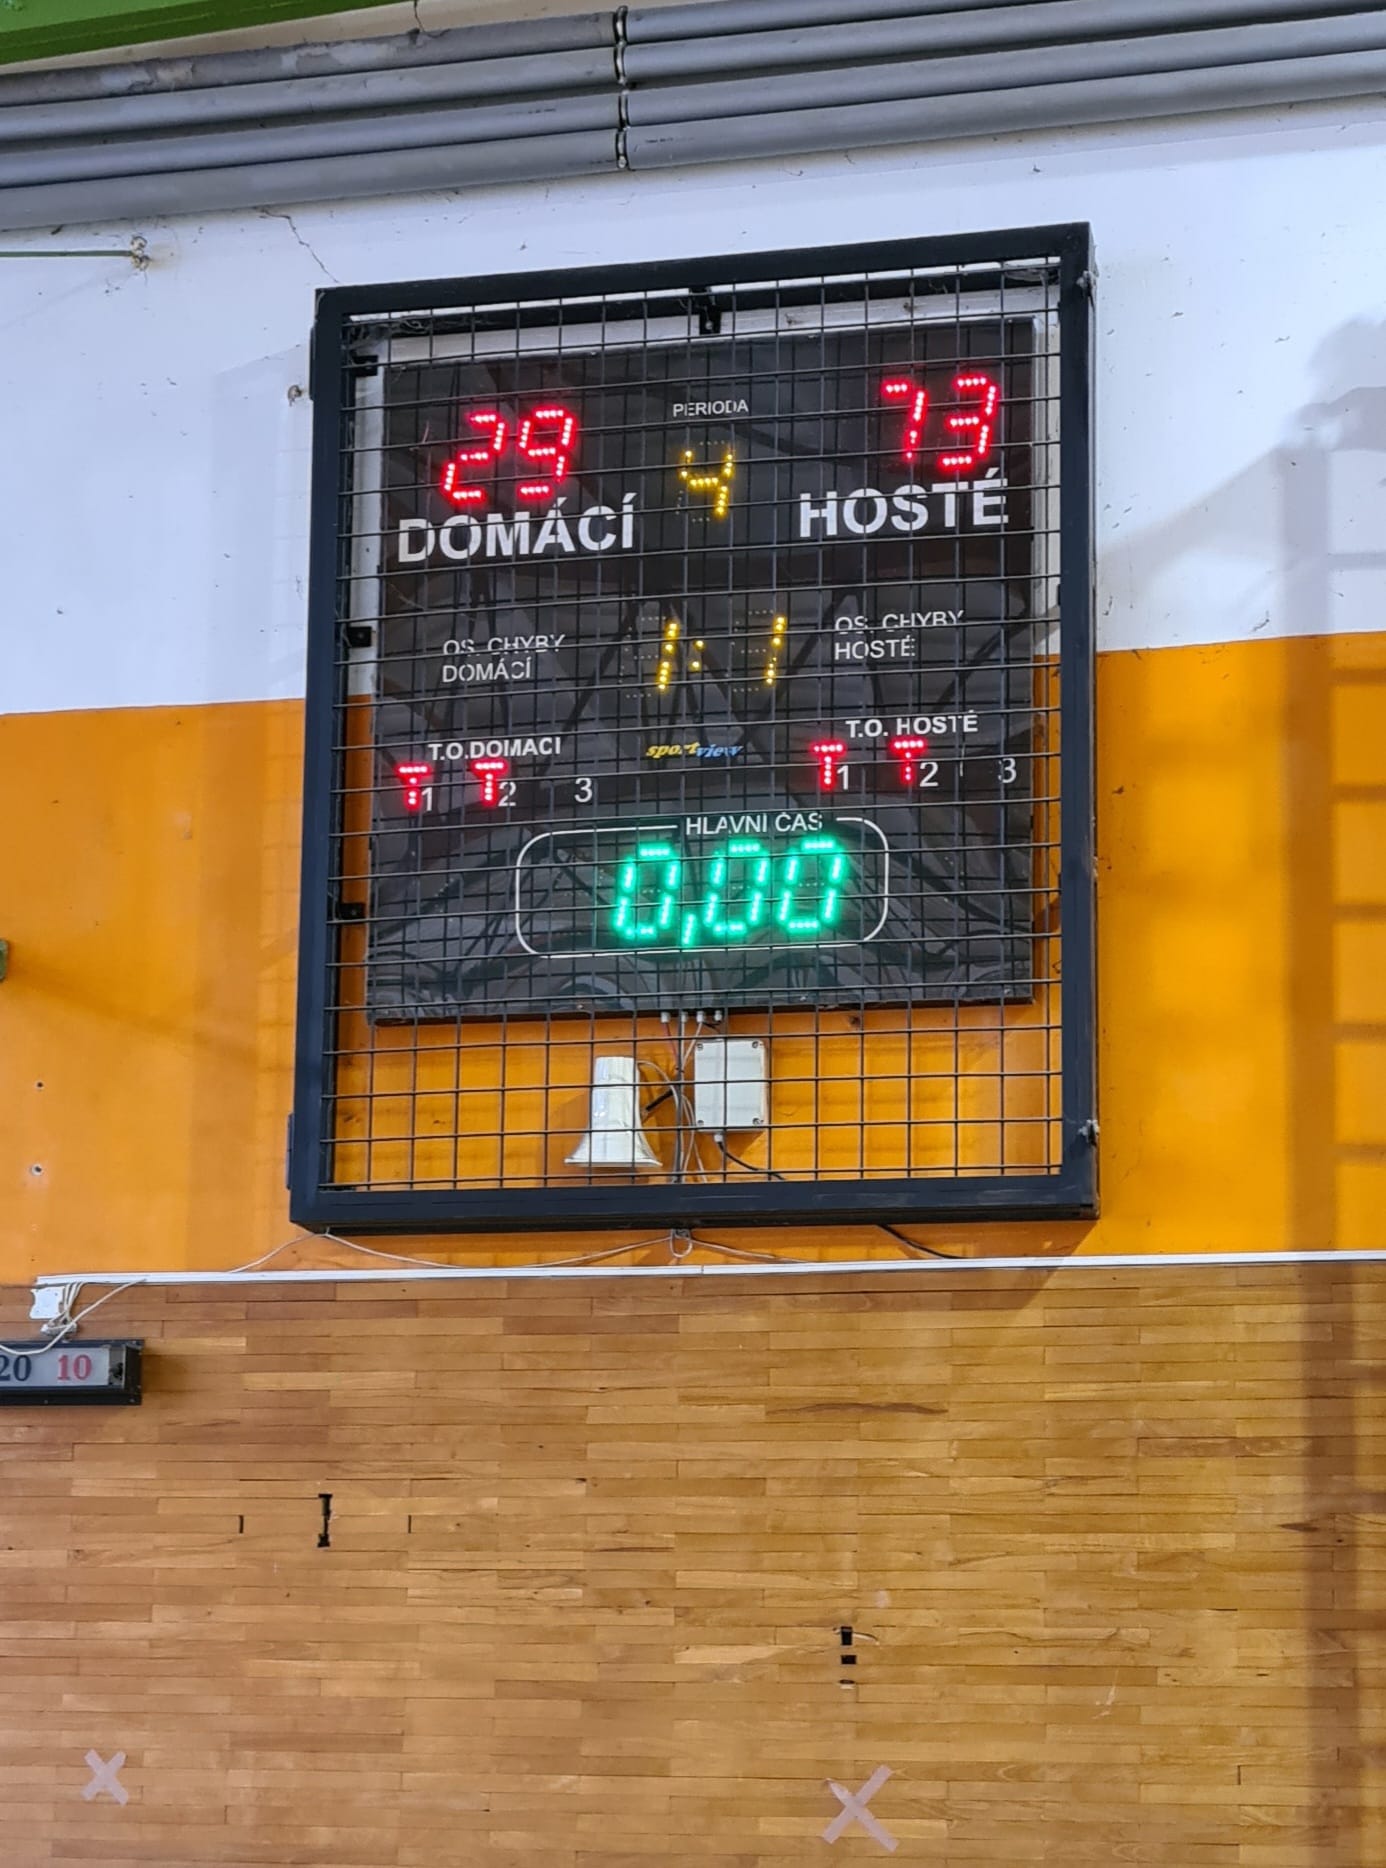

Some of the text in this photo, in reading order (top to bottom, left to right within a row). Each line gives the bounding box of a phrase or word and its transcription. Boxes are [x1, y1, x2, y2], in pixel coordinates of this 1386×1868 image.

[673, 399, 749, 417] PERIODA
[881, 375, 998, 467] 73
[442, 407, 575, 499] 29
[678, 449, 735, 518] 4
[799, 467, 1009, 537] HOSTÉ
[398, 493, 637, 563] DOMÁCÍ
[881, 609, 964, 633] CHYBY
[487, 633, 566, 655] CHYBY
[834, 634, 916, 660] HOSTÉ
[442, 656, 532, 683] DOMÁCÍ
[896, 709, 978, 736] HOSTÉ
[837, 764, 850, 790] 1
[919, 761, 939, 787] 2
[997, 756, 1018, 784] 3
[421, 786, 434, 812] 1
[498, 781, 517, 808] 2
[574, 776, 594, 803] 3
[0, 1354, 92, 1381] 20 10
